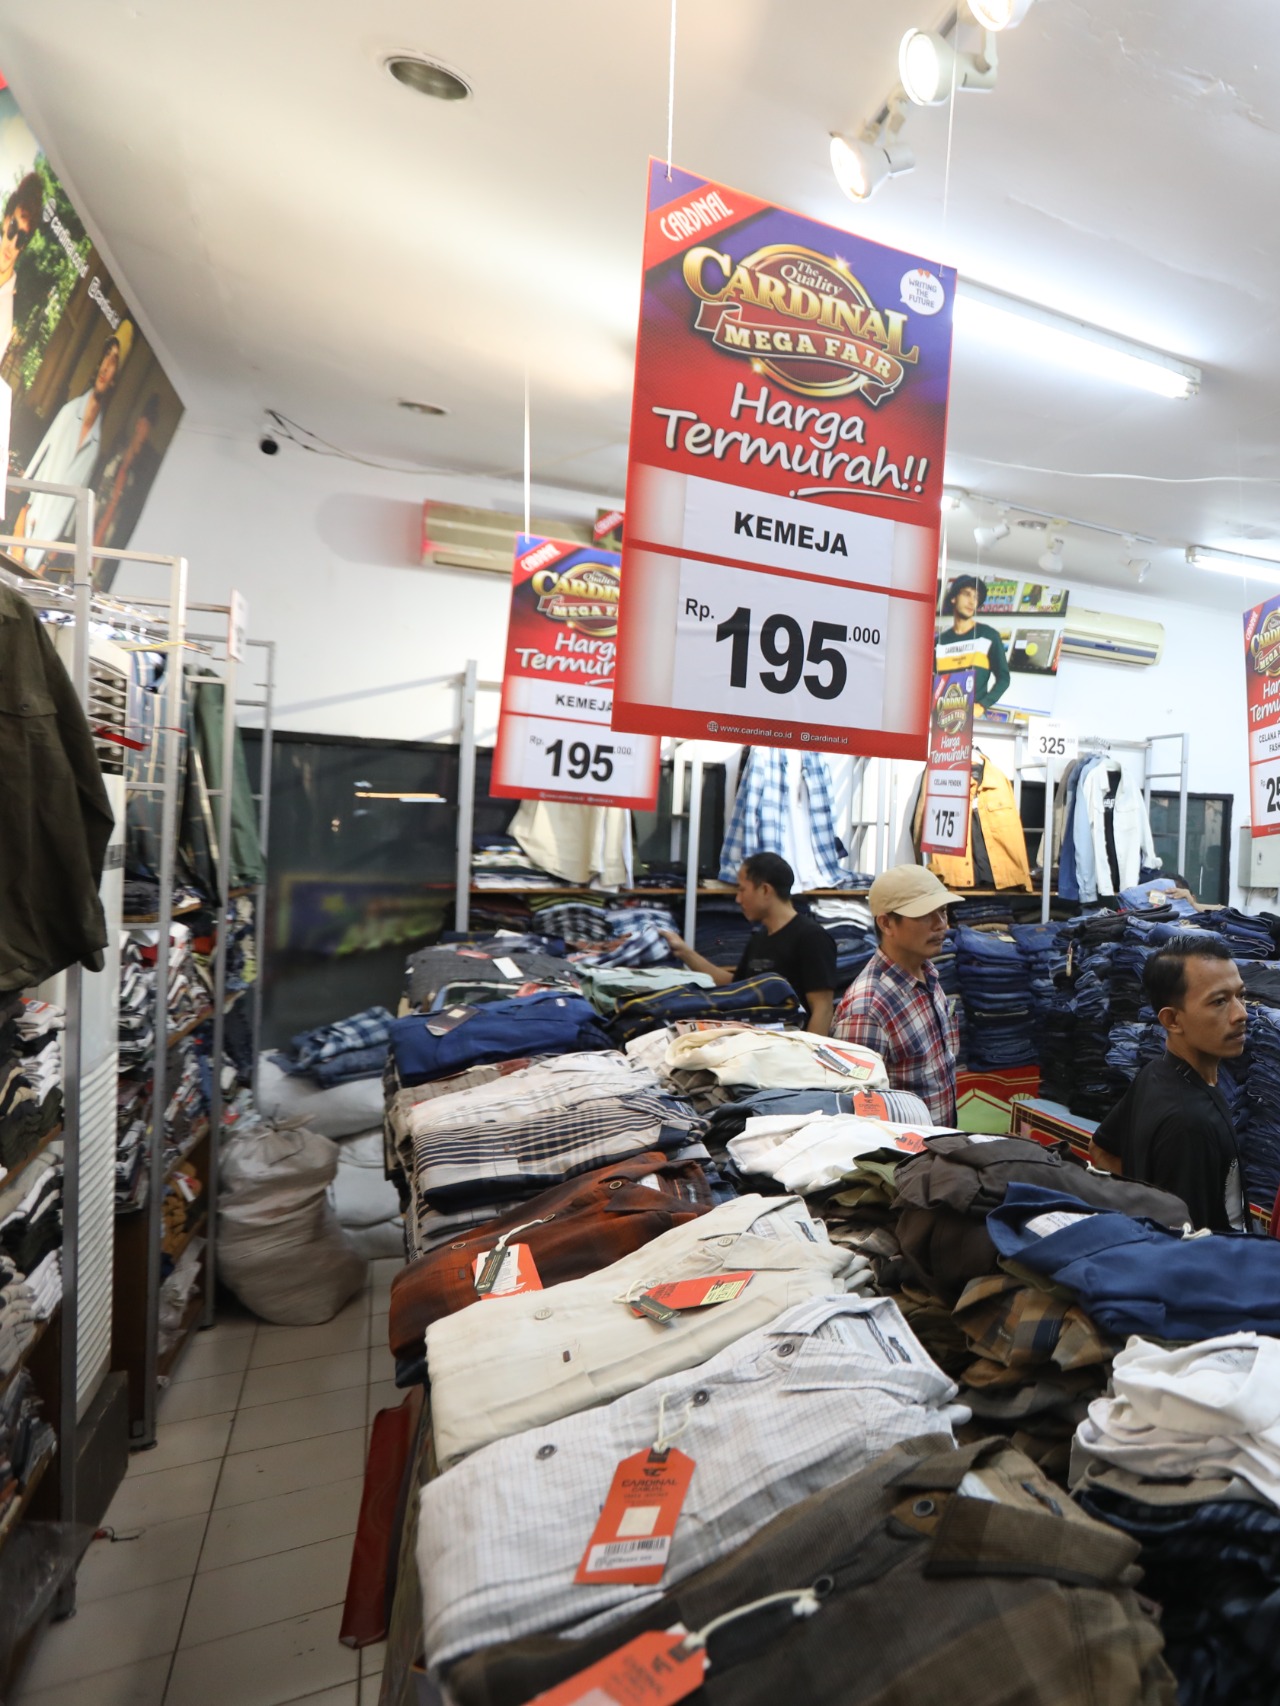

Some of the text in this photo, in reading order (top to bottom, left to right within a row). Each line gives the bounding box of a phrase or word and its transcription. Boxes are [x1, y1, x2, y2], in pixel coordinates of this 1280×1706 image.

[660, 191, 734, 241] CARDINAL
[780, 264, 843, 296] Quality
[797, 261, 820, 277] The
[909, 278, 937, 293] WRITING
[916, 289, 929, 297] THE
[683, 247, 919, 363] CARDINAL
[908, 294, 935, 308] FUTURE
[724, 324, 891, 378] MEGA FAIR
[730, 382, 864, 449] Harga
[652, 406, 928, 492] Termurah!!
[734, 511, 848, 556] KEMEJA
[552, 605, 601, 617] MEGA
[685, 598, 715, 621] Rp.
[715, 607, 847, 699] 195
[720, 724, 848, 745] www.cardinal.co.id cardinal.id
[941, 736, 960, 752] Harga
[1039, 736, 1065, 755] 325
[1259, 731, 1276, 743] CELANA
[545, 739, 614, 781] 195
[935, 809, 954, 837] 175
[621, 1479, 678, 1488] CARDINAL
